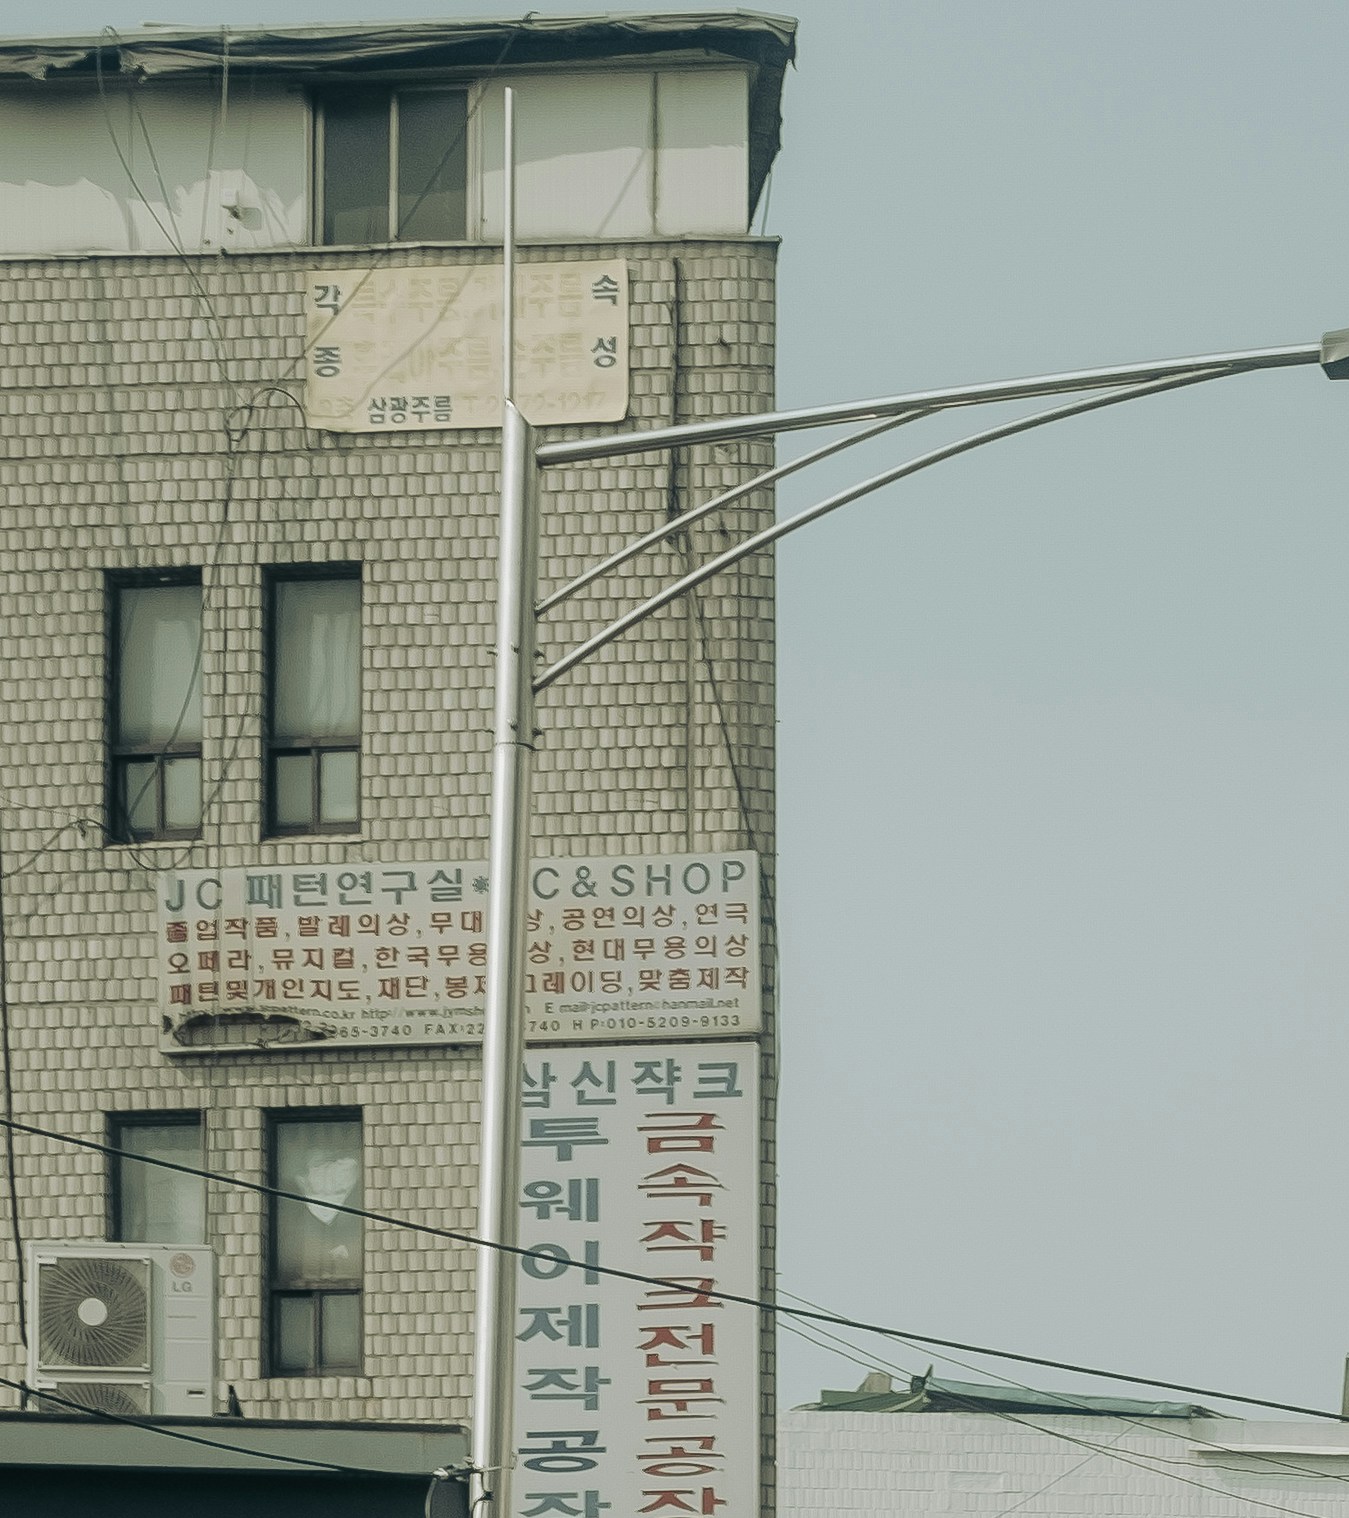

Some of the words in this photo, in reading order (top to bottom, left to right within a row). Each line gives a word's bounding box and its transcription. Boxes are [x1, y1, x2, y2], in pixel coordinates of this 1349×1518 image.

[367, 394, 453, 425] 삼광주름
[165, 878, 223, 912] JC
[246, 868, 464, 909] 패턴연구실
[561, 903, 688, 932] 공연의상,
[696, 902, 749, 926] 연극
[572, 933, 748, 963] 현대무용의상
[638, 966, 749, 992] 맞춤제작
[521, 1059, 744, 1108] 삼신쟉크
[171, 1280, 194, 1294] LG
